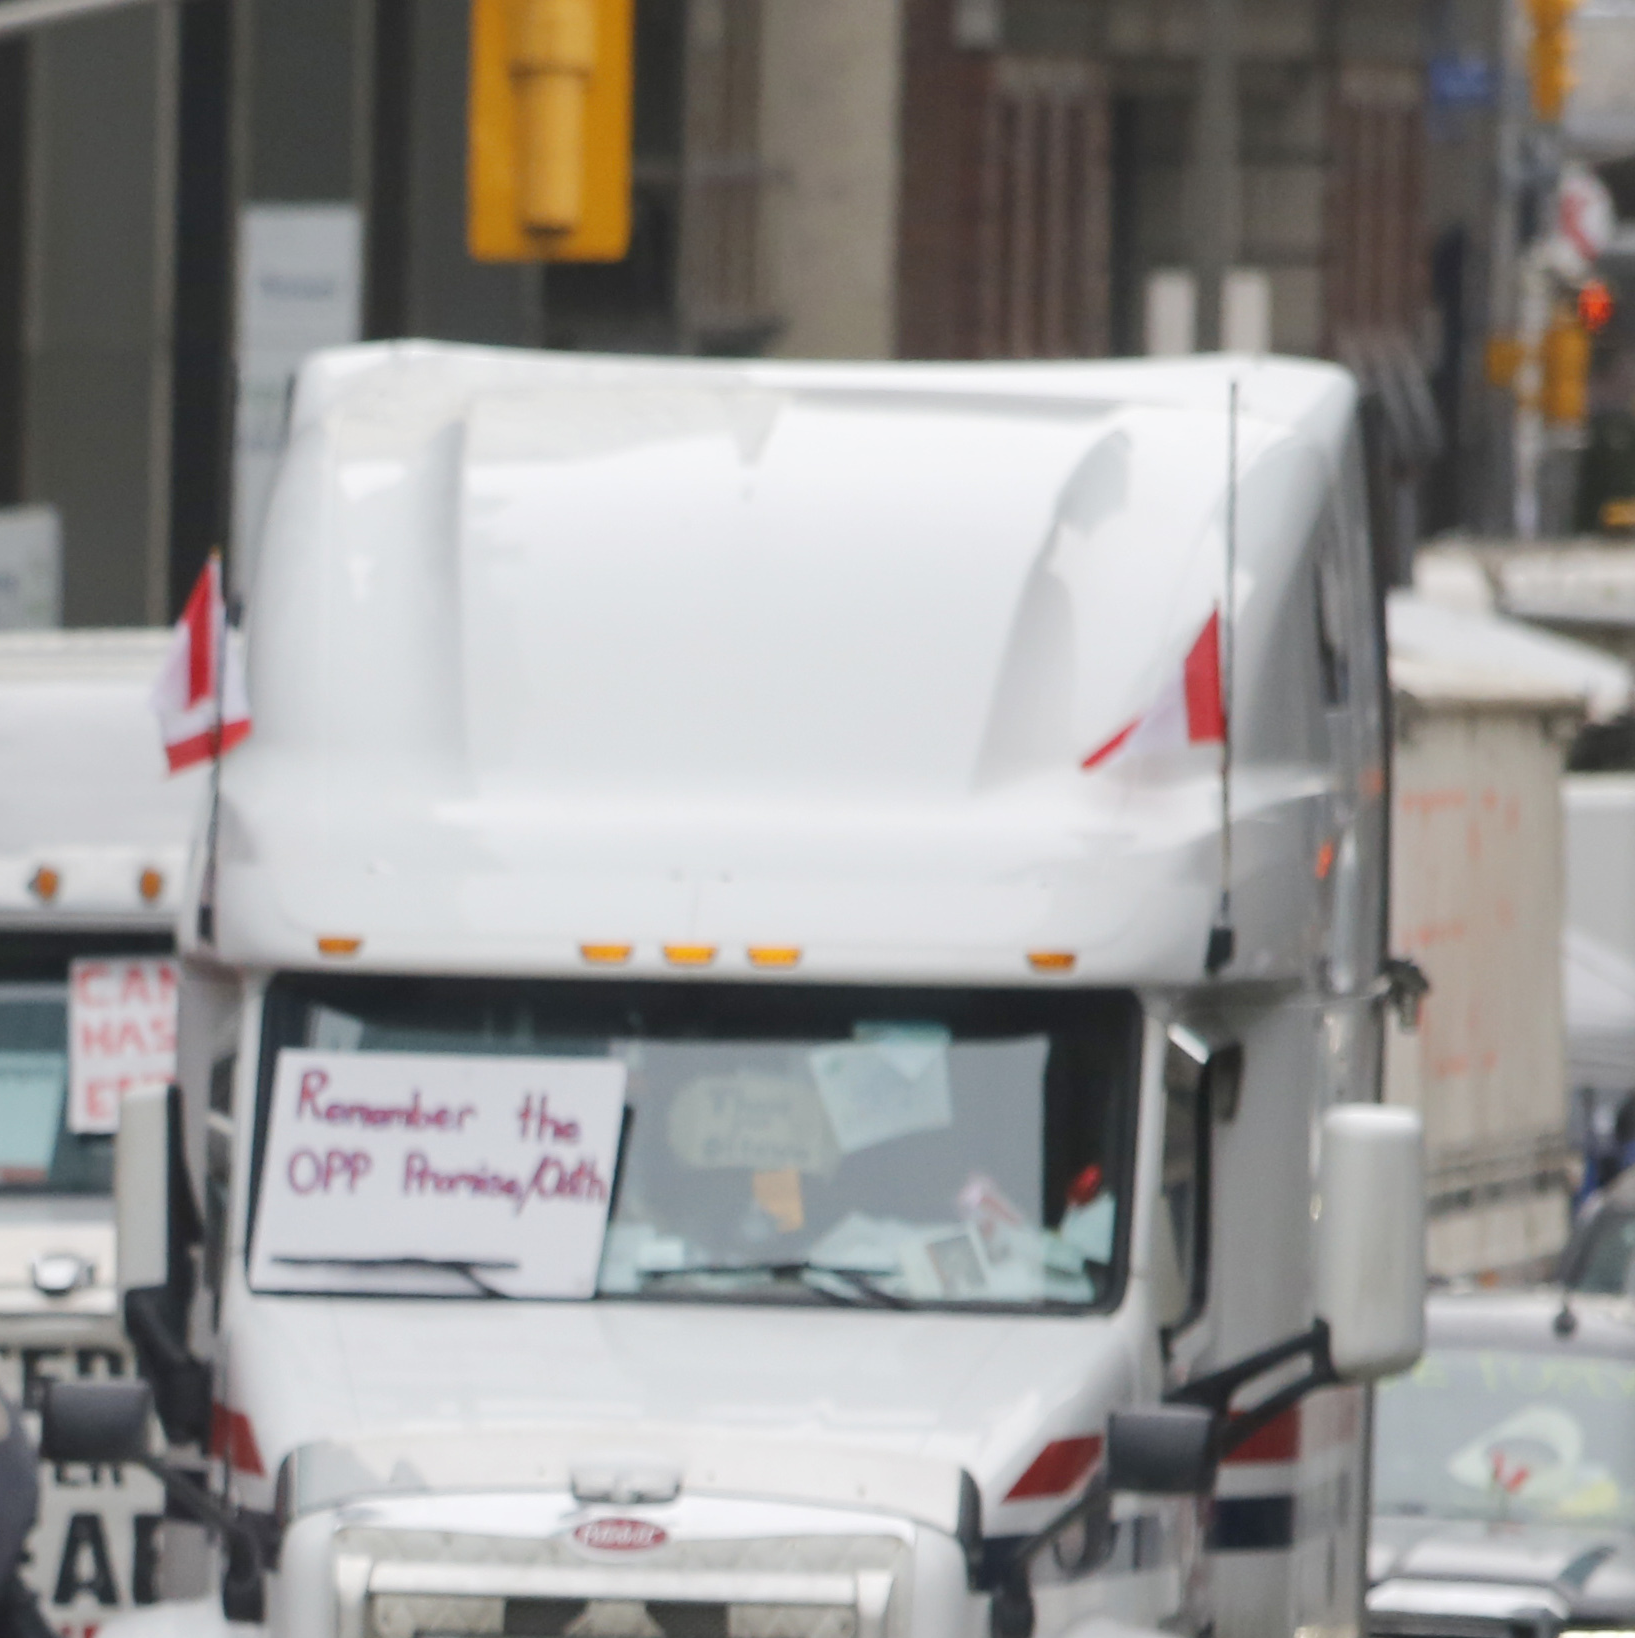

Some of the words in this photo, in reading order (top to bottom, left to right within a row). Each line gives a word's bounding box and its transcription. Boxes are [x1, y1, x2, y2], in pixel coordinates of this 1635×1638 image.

[296, 1069, 475, 1129] Remember
[518, 1092, 579, 1144] the
[287, 1150, 372, 1197] OPP
